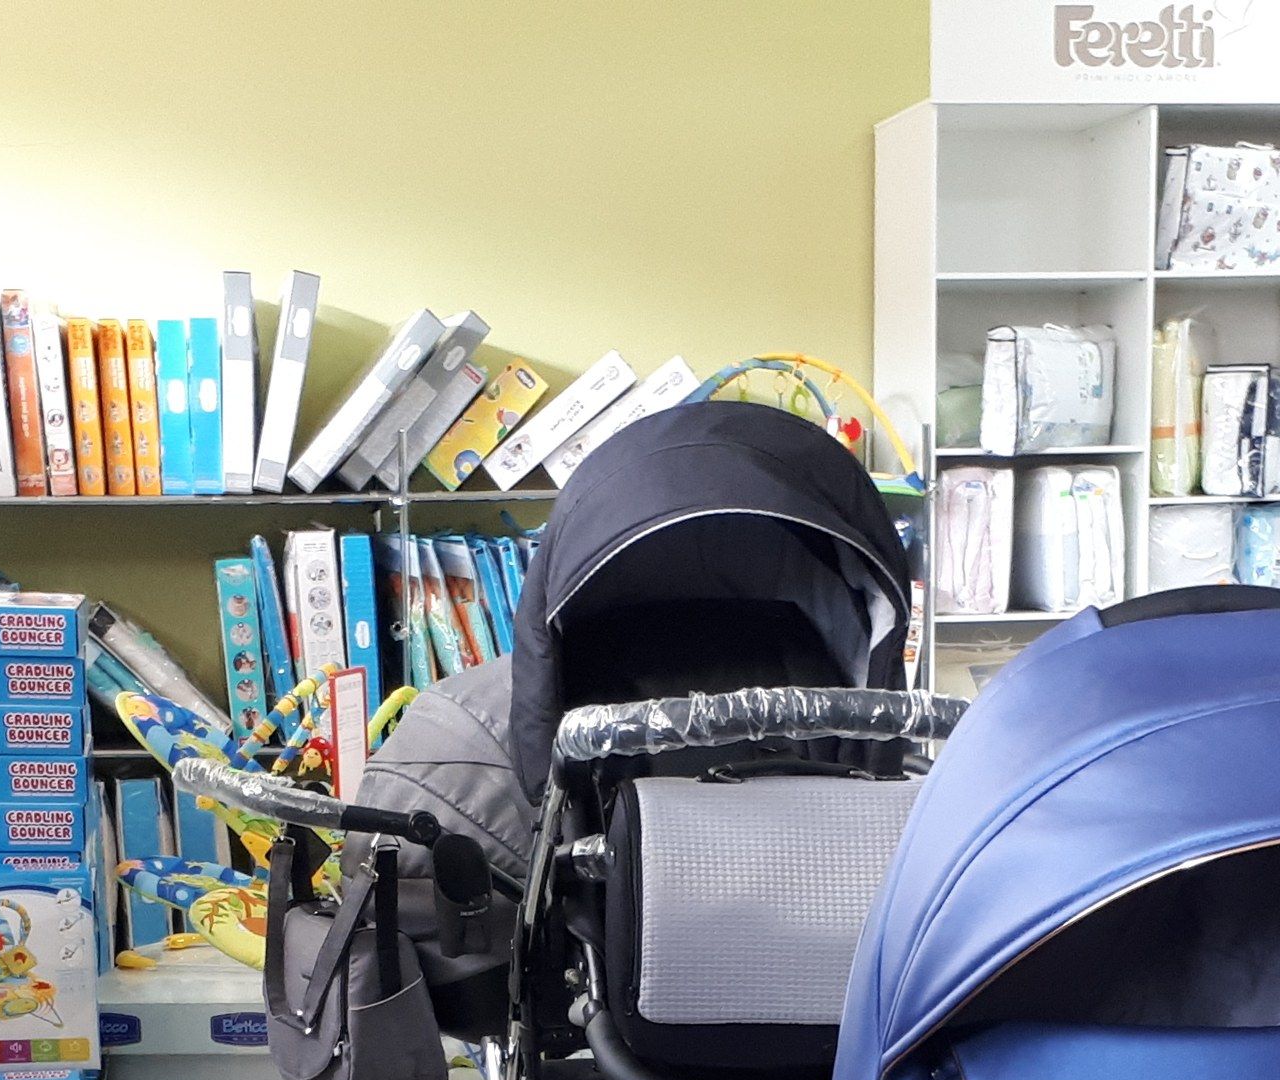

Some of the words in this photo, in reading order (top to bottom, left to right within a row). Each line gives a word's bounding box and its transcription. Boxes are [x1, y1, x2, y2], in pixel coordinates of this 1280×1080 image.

[1053, 4, 1215, 69] Feretti
[1, 630, 63, 643] BOUNCER
[7, 665, 74, 678] CRADLING
[10, 680, 71, 692] BOUNCER
[6, 714, 72, 726] CRADLING
[9, 729, 69, 741] BOUNCER
[10, 763, 76, 775] CRADLING
[13, 778, 74, 790] BOUNCER
[7, 812, 73, 824] CRADLING
[10, 827, 71, 838] BOUNCER
[223, 1019, 268, 1033] Beticc
